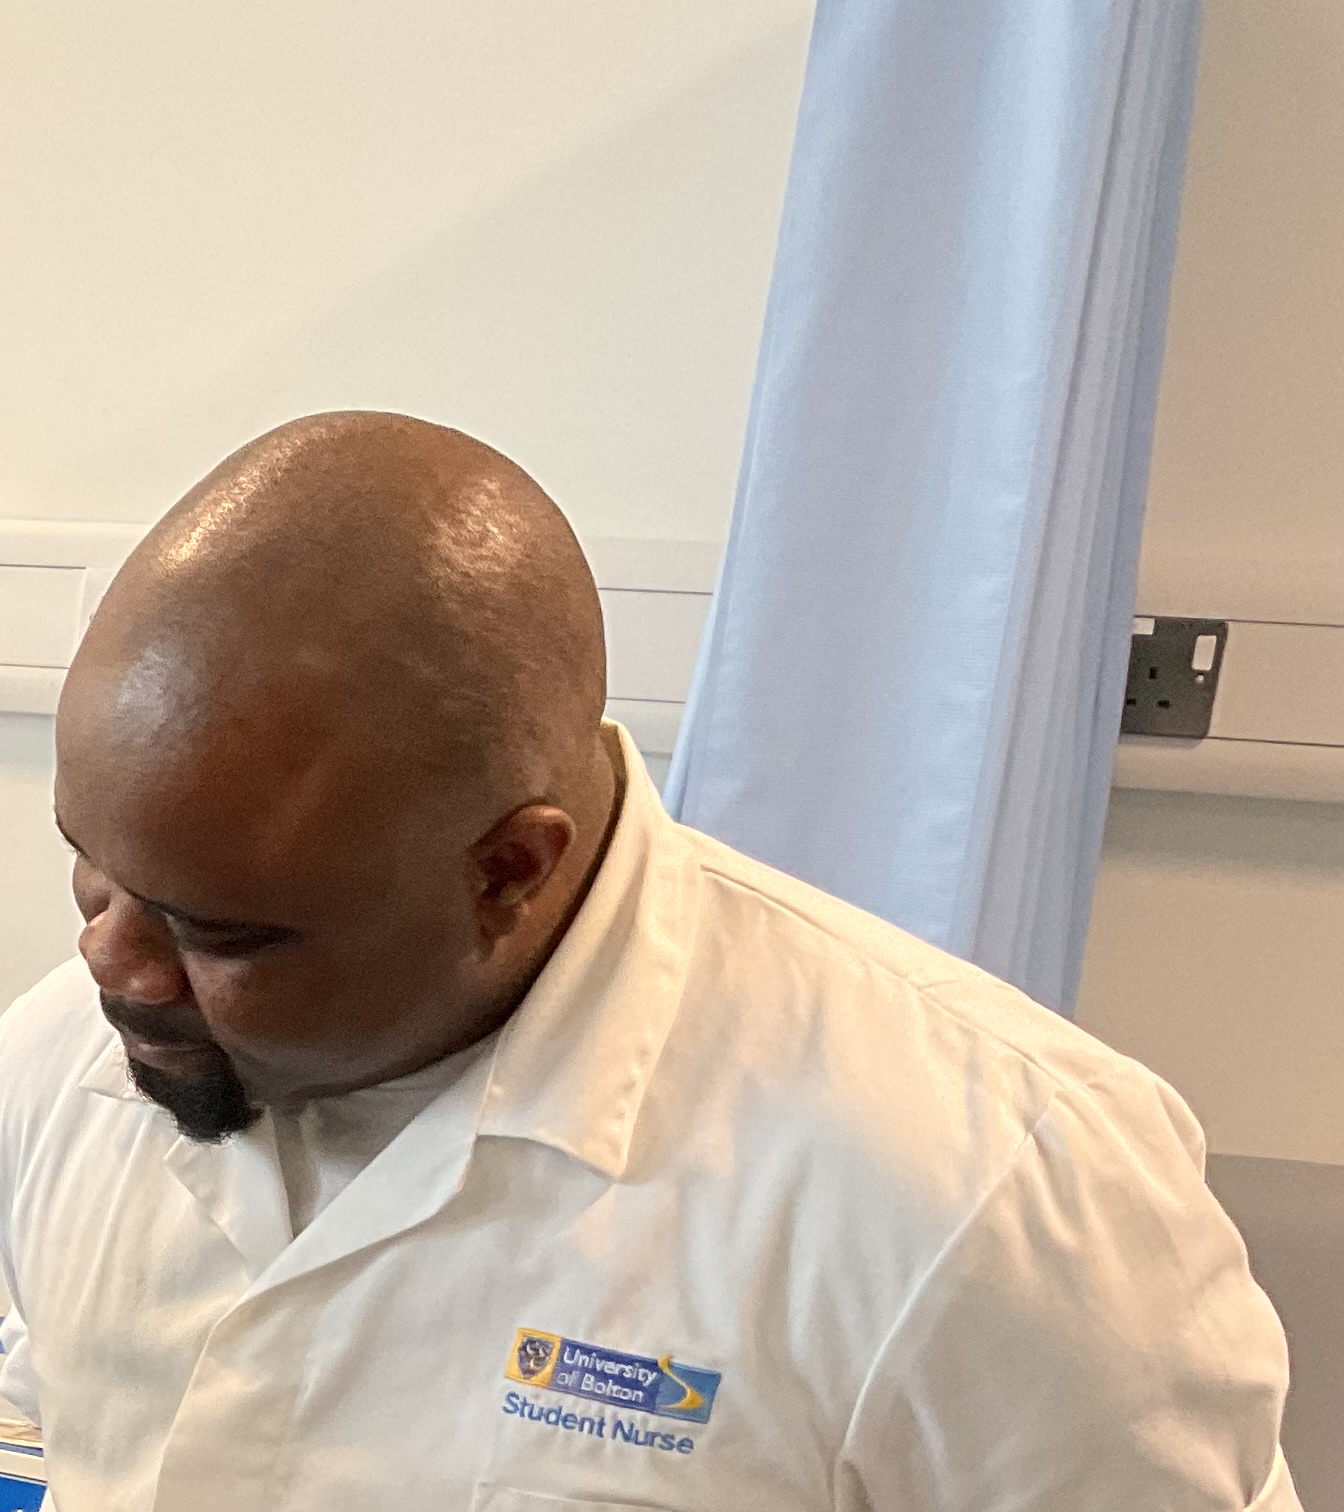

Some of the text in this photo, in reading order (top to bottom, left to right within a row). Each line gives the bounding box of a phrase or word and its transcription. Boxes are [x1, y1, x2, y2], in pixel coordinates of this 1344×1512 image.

[562, 1345, 658, 1386] University
[557, 1370, 644, 1403] of Bolton
[502, 1391, 694, 1455] Student Nurse
